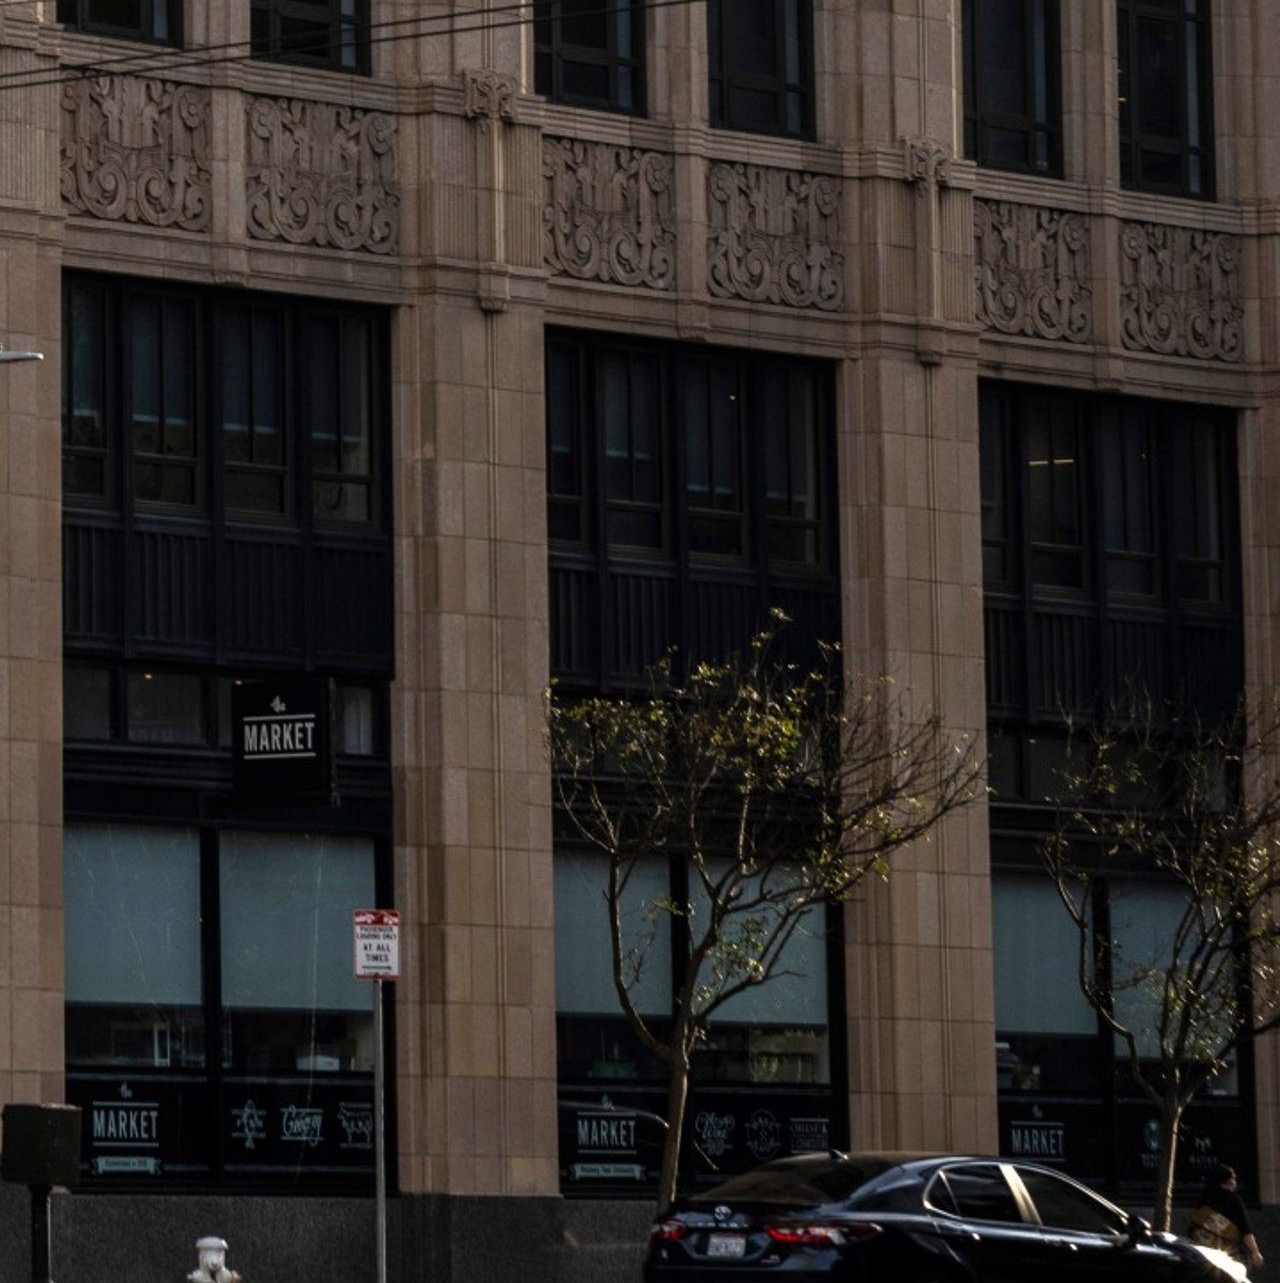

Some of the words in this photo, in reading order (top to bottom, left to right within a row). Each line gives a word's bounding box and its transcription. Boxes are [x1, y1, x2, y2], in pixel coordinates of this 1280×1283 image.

[243, 721, 315, 753] MARKET
[363, 943, 372, 952] AT
[376, 944, 391, 952] ALL
[365, 953, 390, 963] TIMES
[92, 1108, 159, 1140] MARKET
[576, 1118, 637, 1148] MARKET
[1010, 1127, 1065, 1156] MARKET
